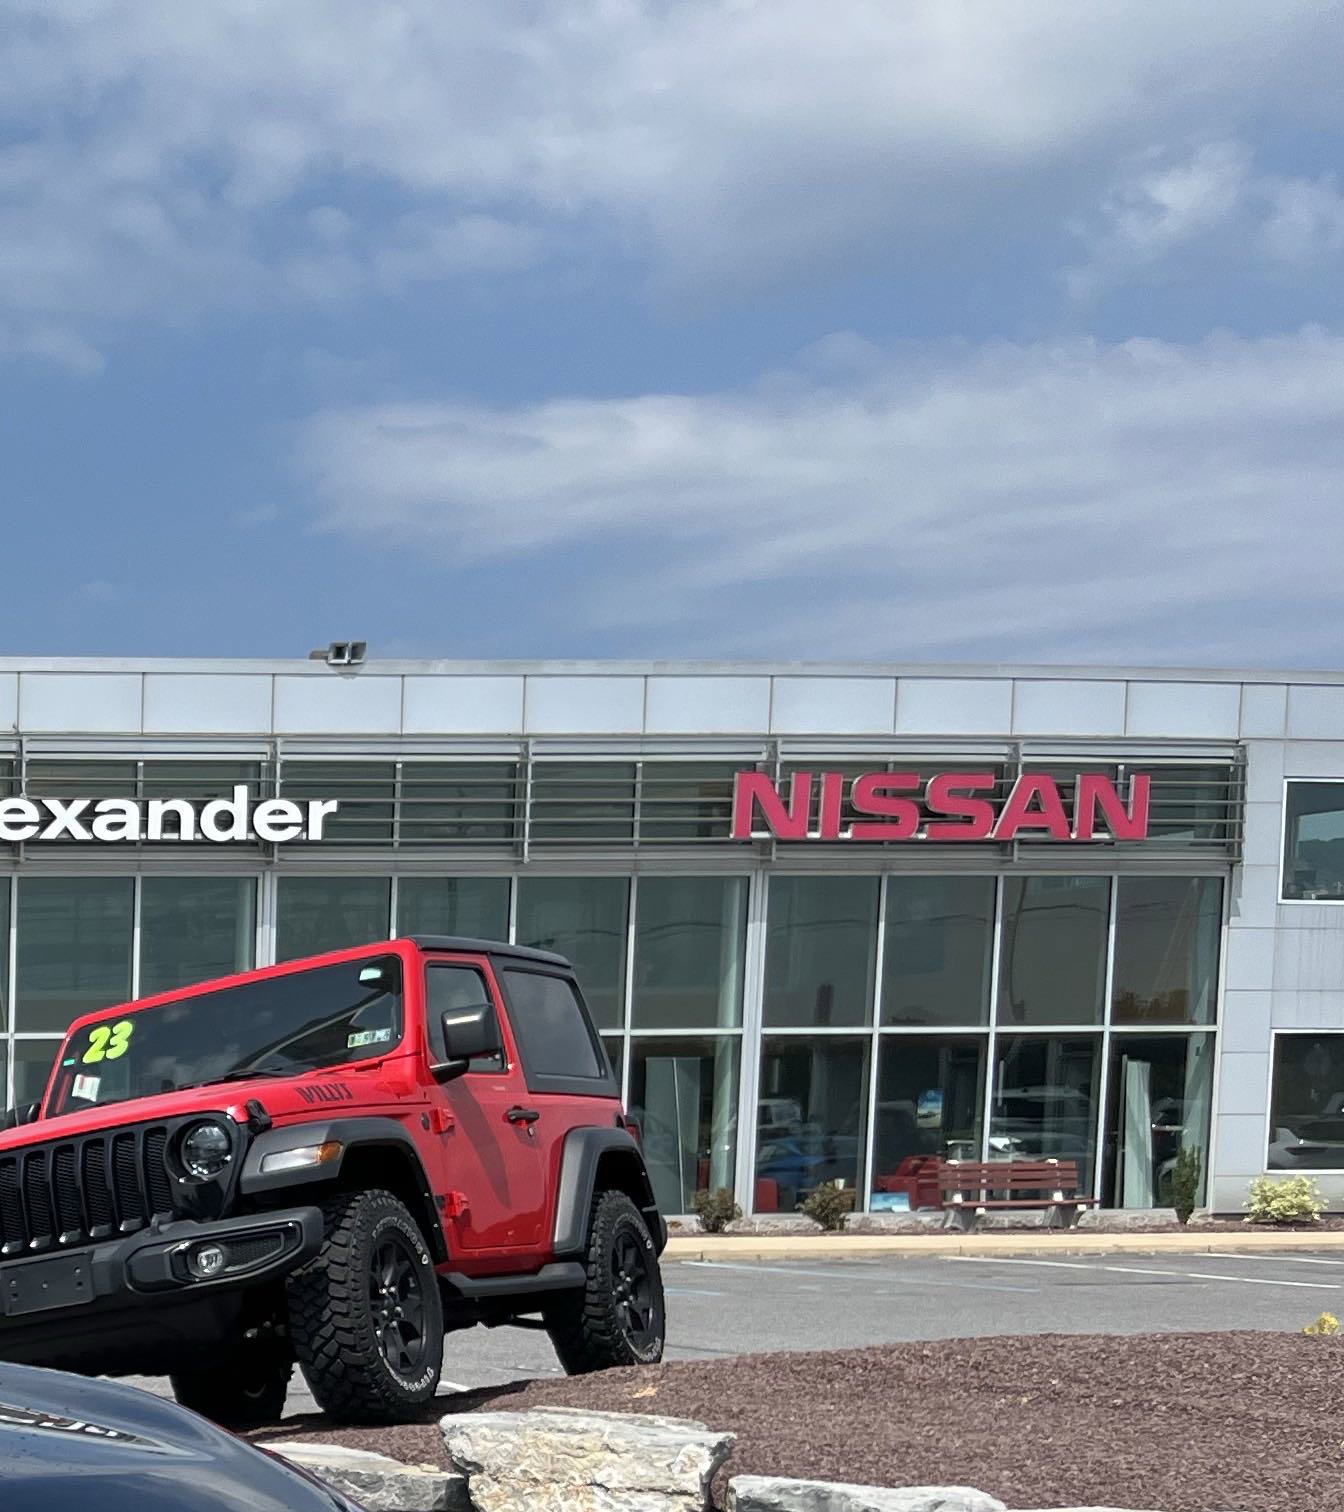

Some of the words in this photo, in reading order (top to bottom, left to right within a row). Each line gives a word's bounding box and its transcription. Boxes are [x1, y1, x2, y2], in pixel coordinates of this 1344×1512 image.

[730, 771, 1151, 841] NISSAN
[82, 1021, 133, 1064] 23
[295, 1083, 353, 1104] WILLYS
